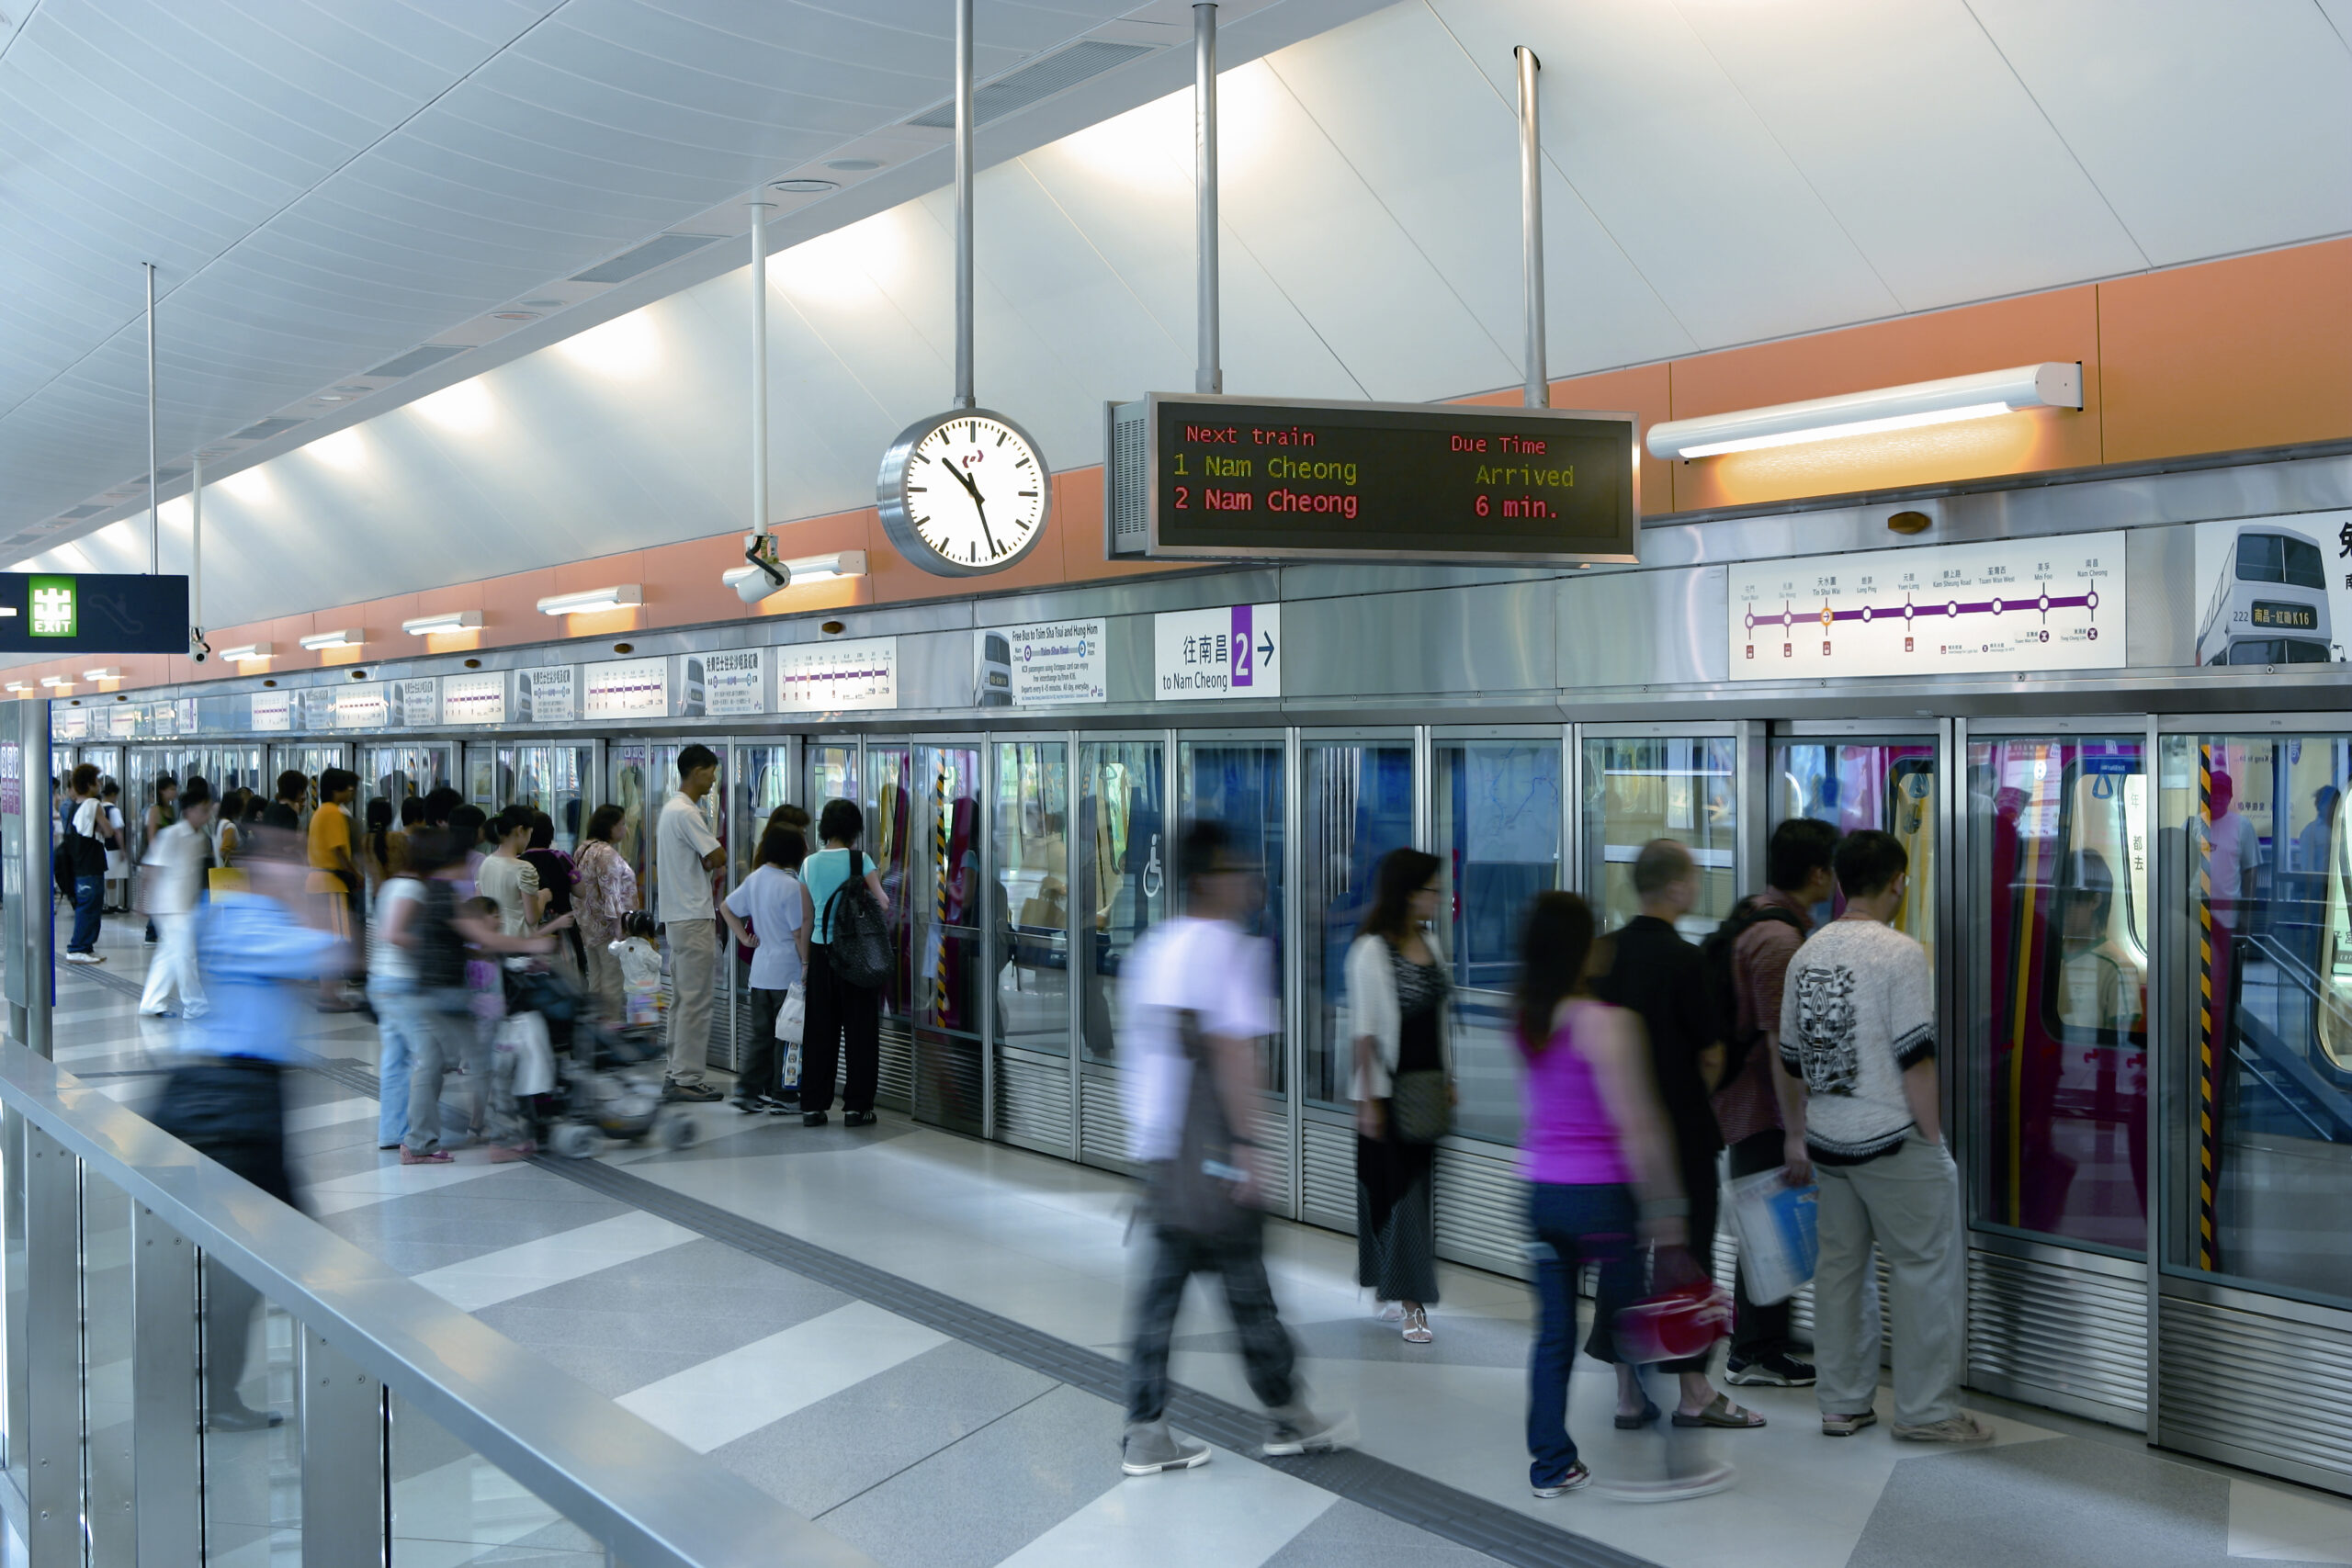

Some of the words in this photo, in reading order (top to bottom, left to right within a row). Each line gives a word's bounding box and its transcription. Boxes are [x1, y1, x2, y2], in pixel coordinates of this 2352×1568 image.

[1186, 424, 1237, 445] Next
[1251, 427, 1316, 447] train
[1451, 434, 1487, 453] Due
[1499, 434, 1547, 455] Time
[1174, 453, 1189, 476] 1
[1205, 455, 1251, 478] Nam
[1268, 455, 1357, 486] Cheong
[1475, 463, 1574, 488] Arrived
[1174, 485, 1189, 510] 2
[1204, 488, 1252, 511] Nam
[1267, 488, 1358, 520] Cheong
[1476, 494, 1490, 517] 6
[1503, 494, 1558, 519] min.
[34, 588, 71, 620] 出
[2233, 611, 2249, 622] 222
[34, 620, 72, 633] EXIT
[1012, 630, 1022, 642] Free
[1022, 629, 1030, 641] Bus
[1031, 631, 1035, 640] to
[1035, 626, 1046, 639] Tsim
[1046, 626, 1055, 638] Sha
[1055, 625, 1064, 637] Tsui
[1064, 625, 1073, 637] and
[1073, 625, 1086, 639] Hung
[1086, 623, 1099, 635] Hom
[1183, 634, 1227, 665] 往南昌
[1235, 632, 1249, 676] 2
[1163, 674, 1171, 690] to
[1174, 672, 1193, 690] Nam
[1194, 671, 1227, 693] Cheong
